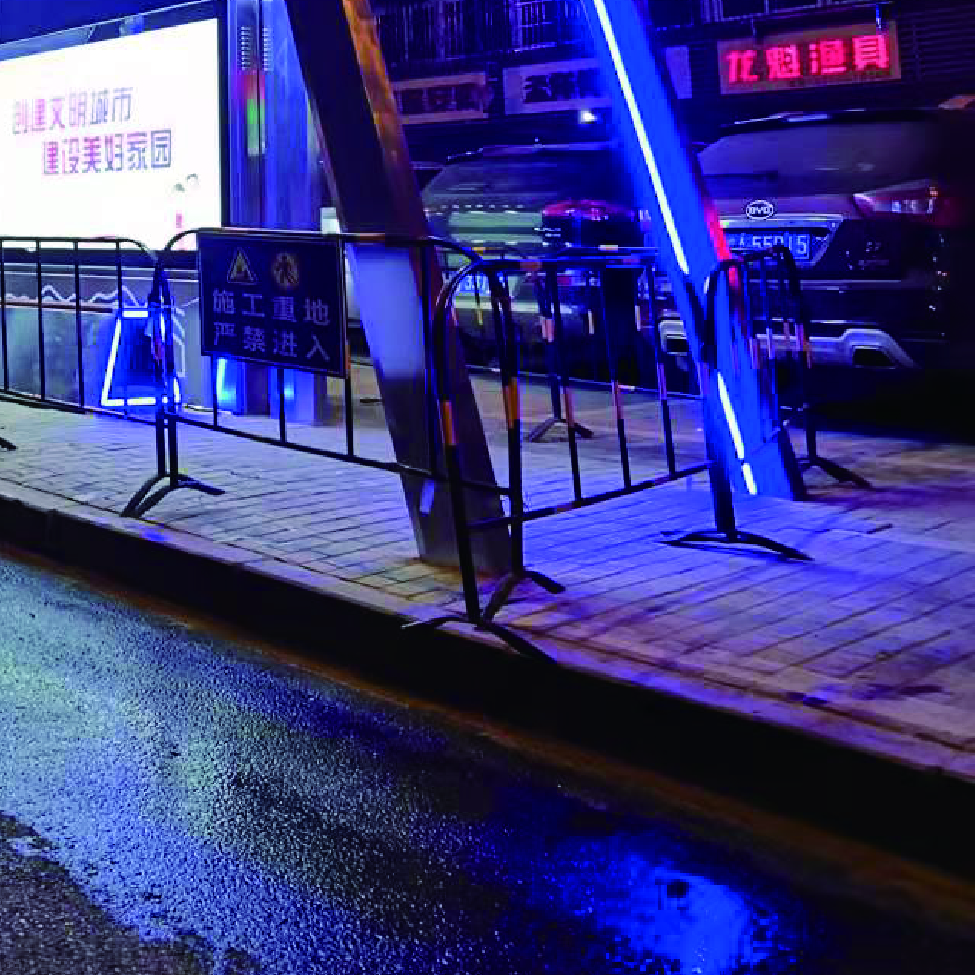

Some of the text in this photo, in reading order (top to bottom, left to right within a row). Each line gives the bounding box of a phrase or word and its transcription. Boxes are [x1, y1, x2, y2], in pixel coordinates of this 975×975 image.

[12, 87, 133, 134] 创建文明城市
[42, 129, 172, 174] 建设美好家园
[213, 288, 330, 326] 施工重地
[213, 322, 331, 361] 严禁进入
